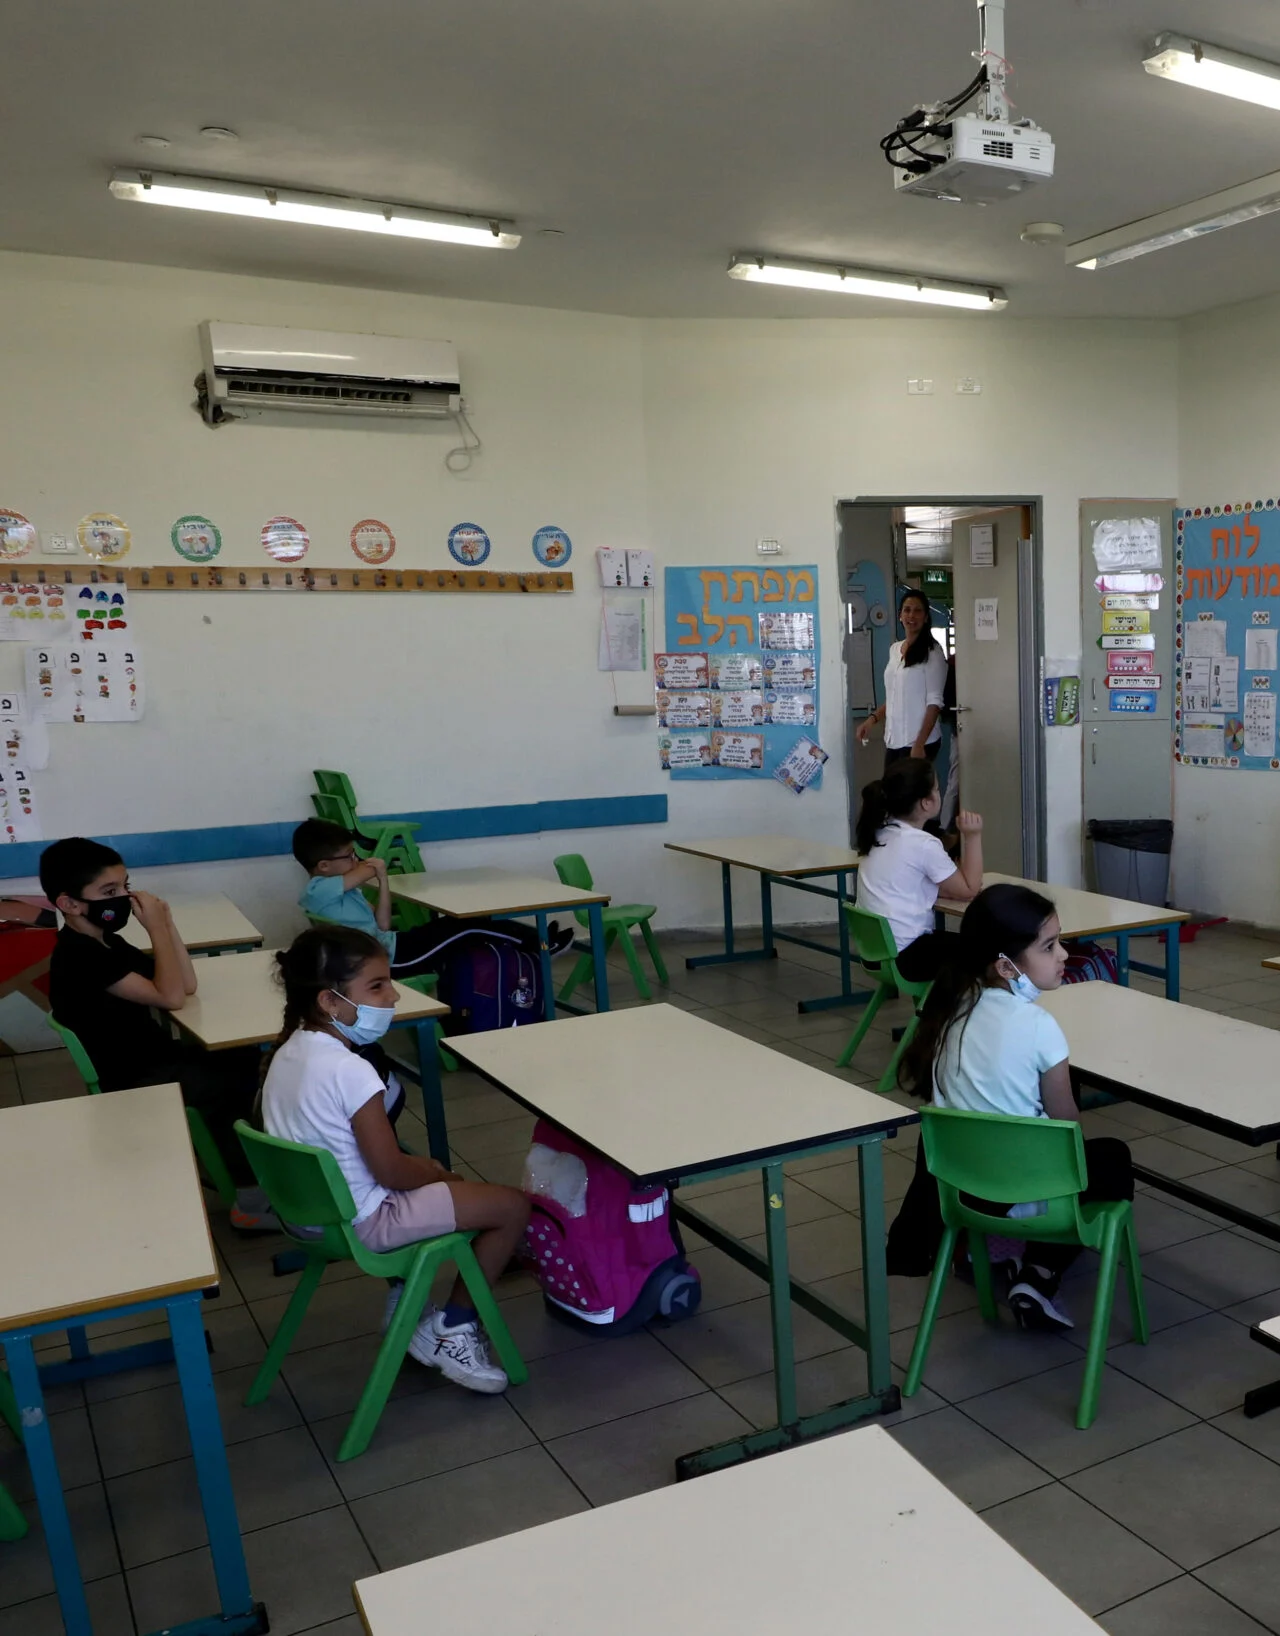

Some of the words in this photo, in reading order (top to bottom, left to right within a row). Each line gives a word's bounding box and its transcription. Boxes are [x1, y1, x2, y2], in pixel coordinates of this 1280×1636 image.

[1210, 513, 1261, 560] לוח
[698, 568, 815, 603] מפתח
[677, 604, 754, 647] הלב
[98, 652, 107, 663] ב
[125, 653, 134, 663] ב
[15, 771, 26, 781] ב
